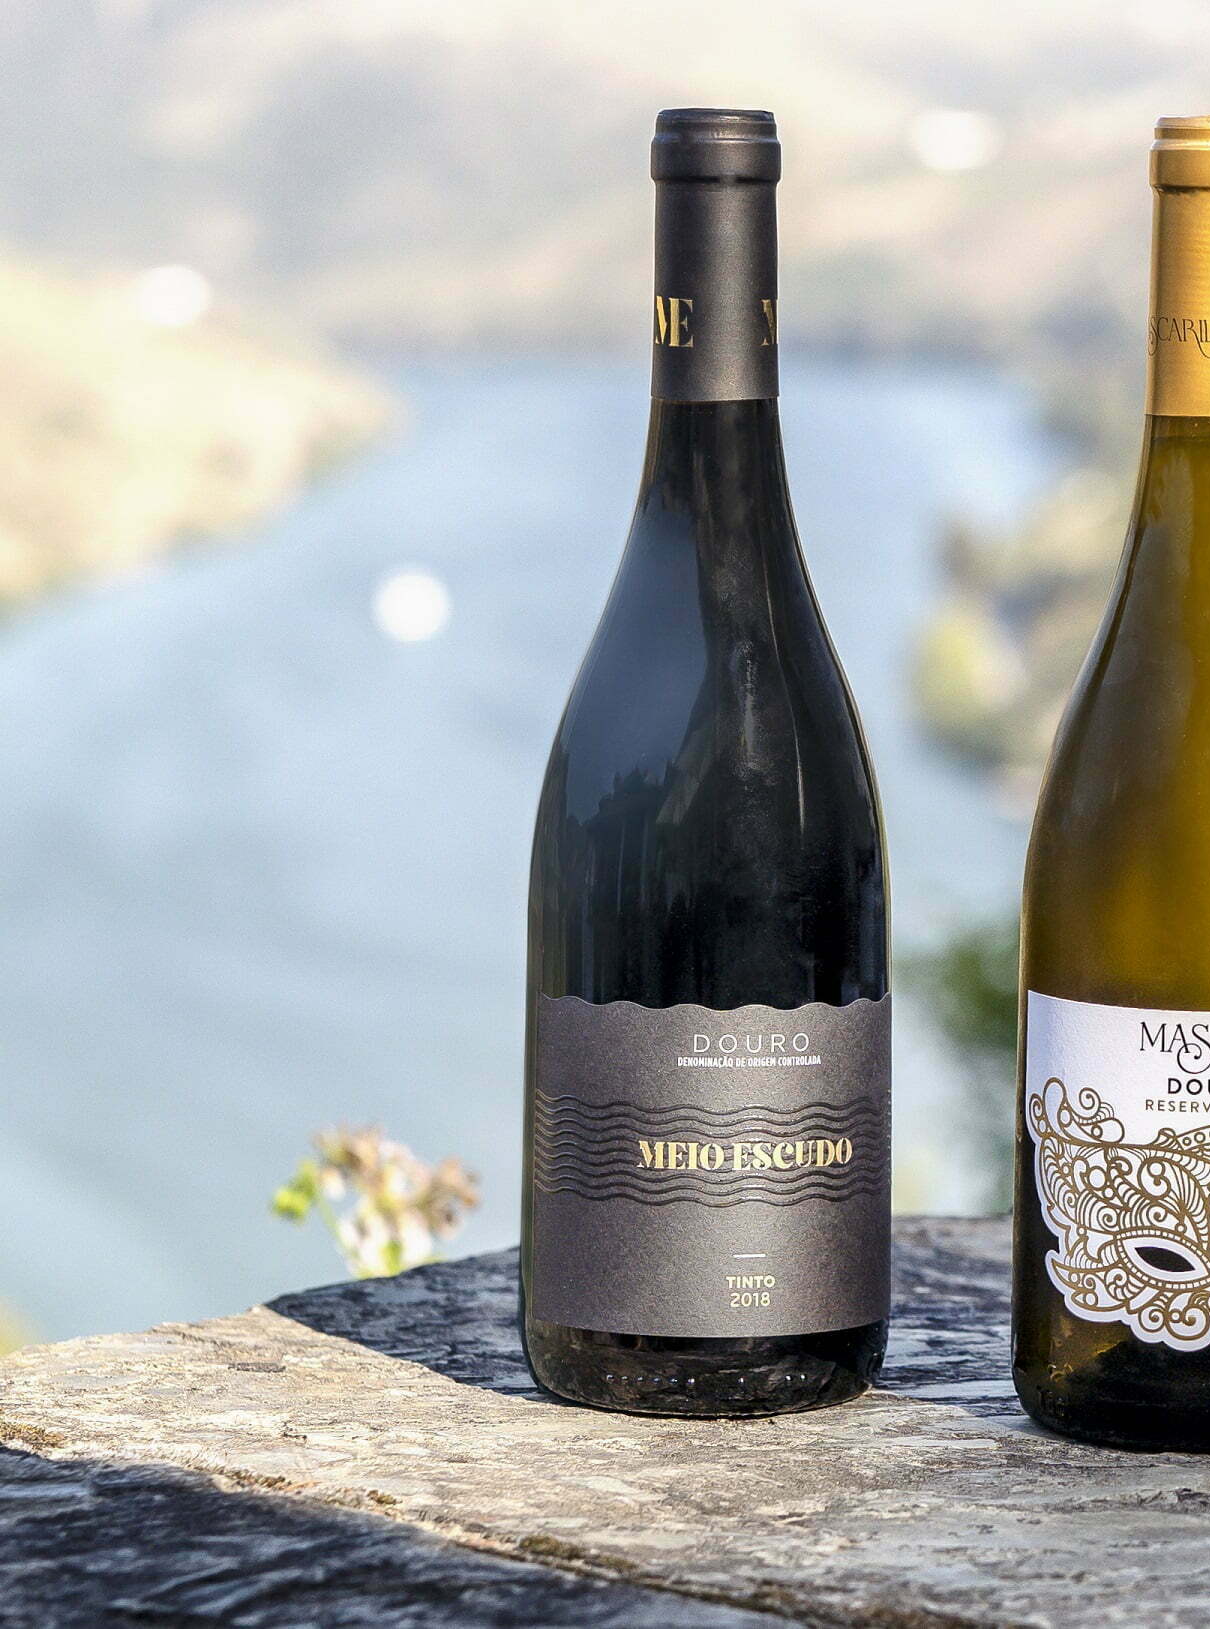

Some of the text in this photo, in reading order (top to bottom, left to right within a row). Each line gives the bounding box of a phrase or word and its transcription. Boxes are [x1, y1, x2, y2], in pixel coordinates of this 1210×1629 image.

[693, 1032, 809, 1054] DOURO
[677, 1055, 822, 1069] DENOMINAÇÃO DE ORIGEM CONTROLADA
[636, 1137, 853, 1171] MEIO ESCUDO
[726, 1275, 776, 1289] TINTO
[730, 1291, 771, 1308] 2018
